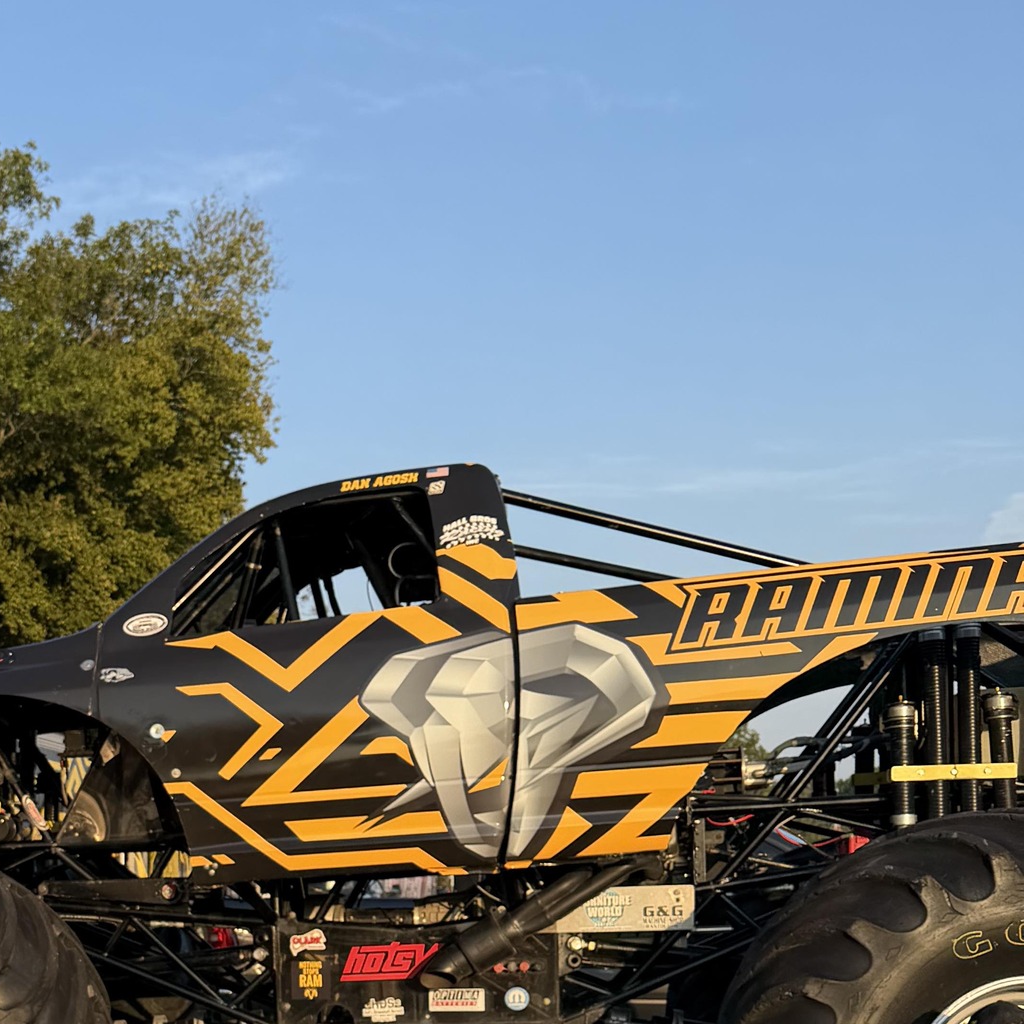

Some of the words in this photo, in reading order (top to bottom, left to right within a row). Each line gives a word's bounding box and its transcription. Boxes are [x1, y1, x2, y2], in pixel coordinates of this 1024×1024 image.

[584, 894, 632, 907] RNITURE
[587, 906, 623, 918] WORLD
[643, 905, 683, 917] G&G
[299, 974, 323, 988] RAM
